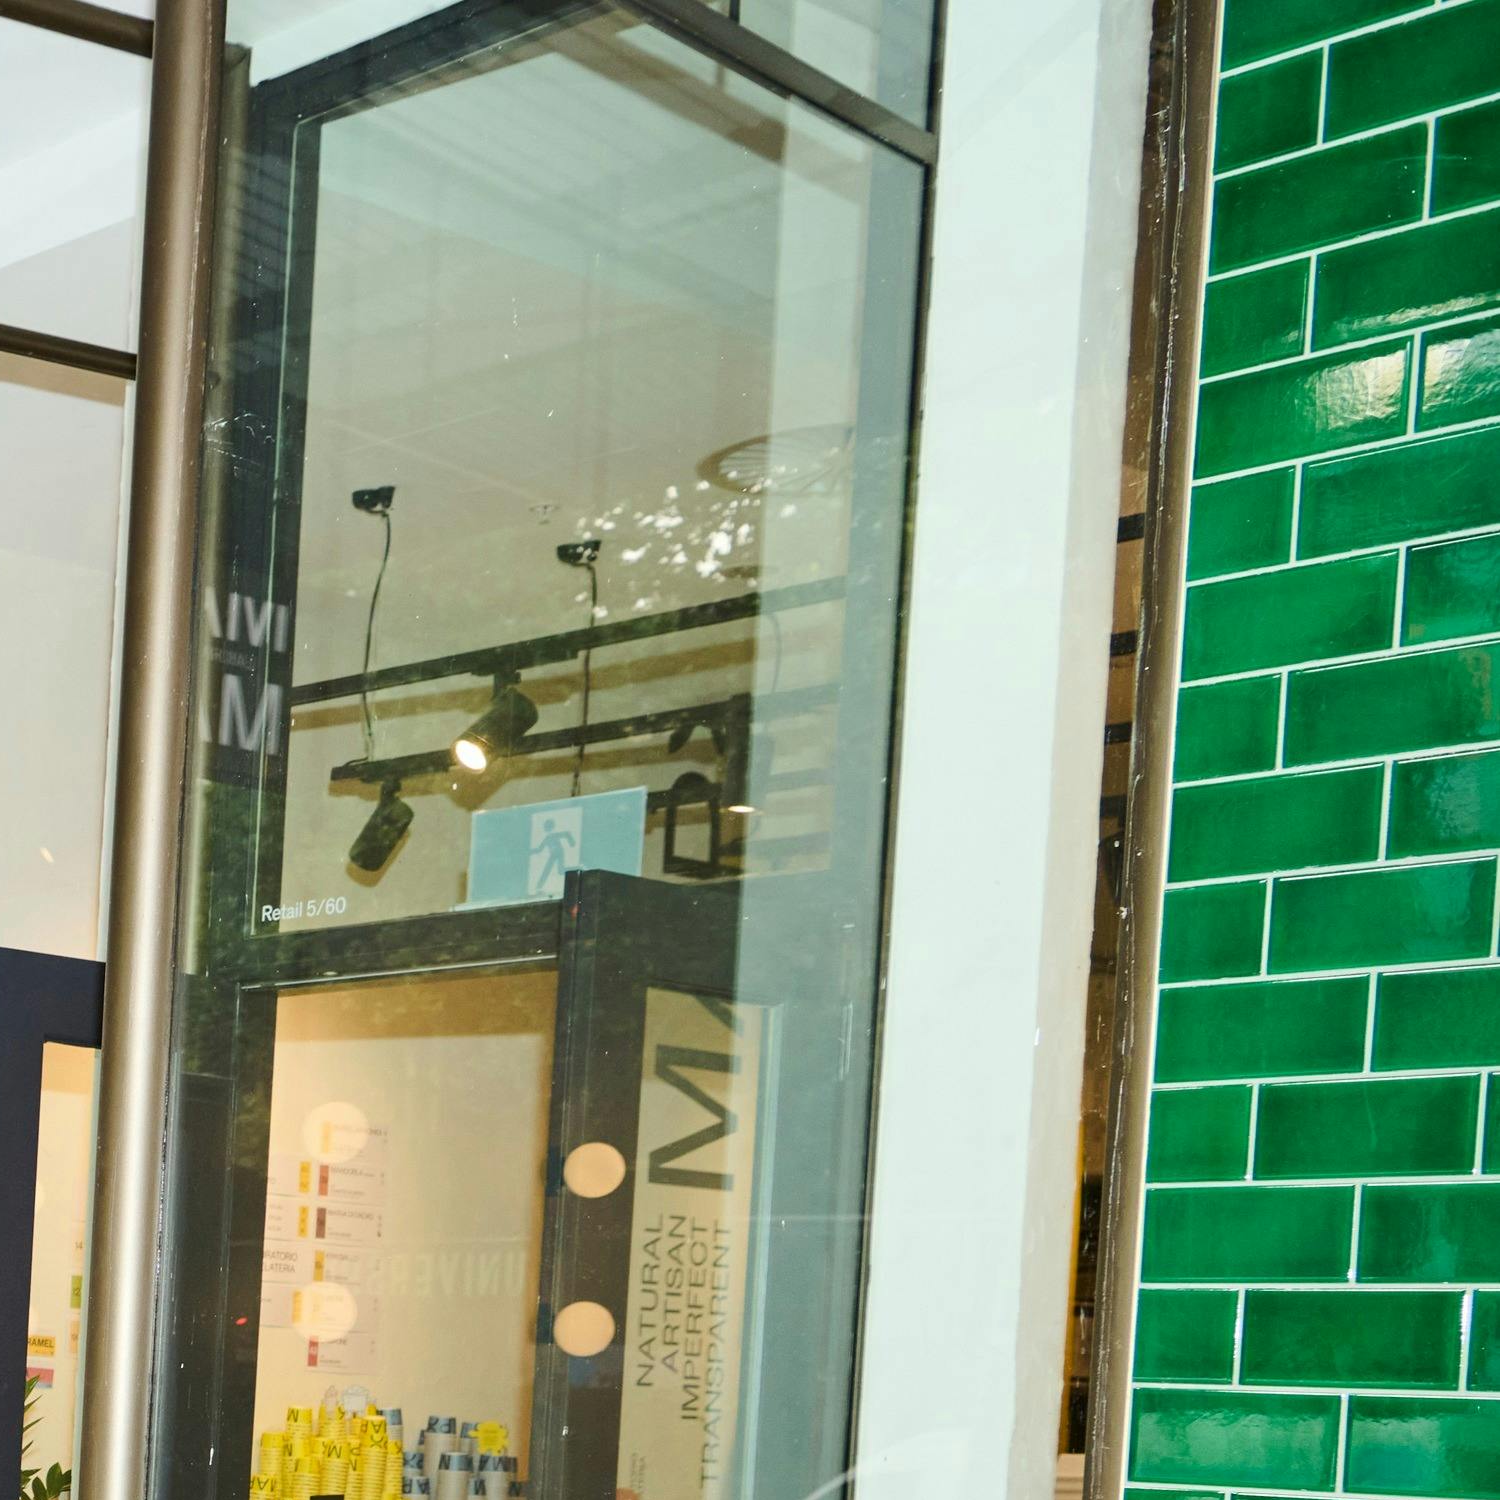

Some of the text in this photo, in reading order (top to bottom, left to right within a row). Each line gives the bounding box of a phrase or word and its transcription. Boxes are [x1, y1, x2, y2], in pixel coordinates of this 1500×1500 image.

[261, 896, 347, 922] Retail 5/60
[636, 1213, 664, 1387] NATURAL
[661, 1215, 687, 1373] ARTISAN
[681, 1216, 709, 1420] IMPERFECT
[700, 1219, 732, 1490] TRANSPARENT
